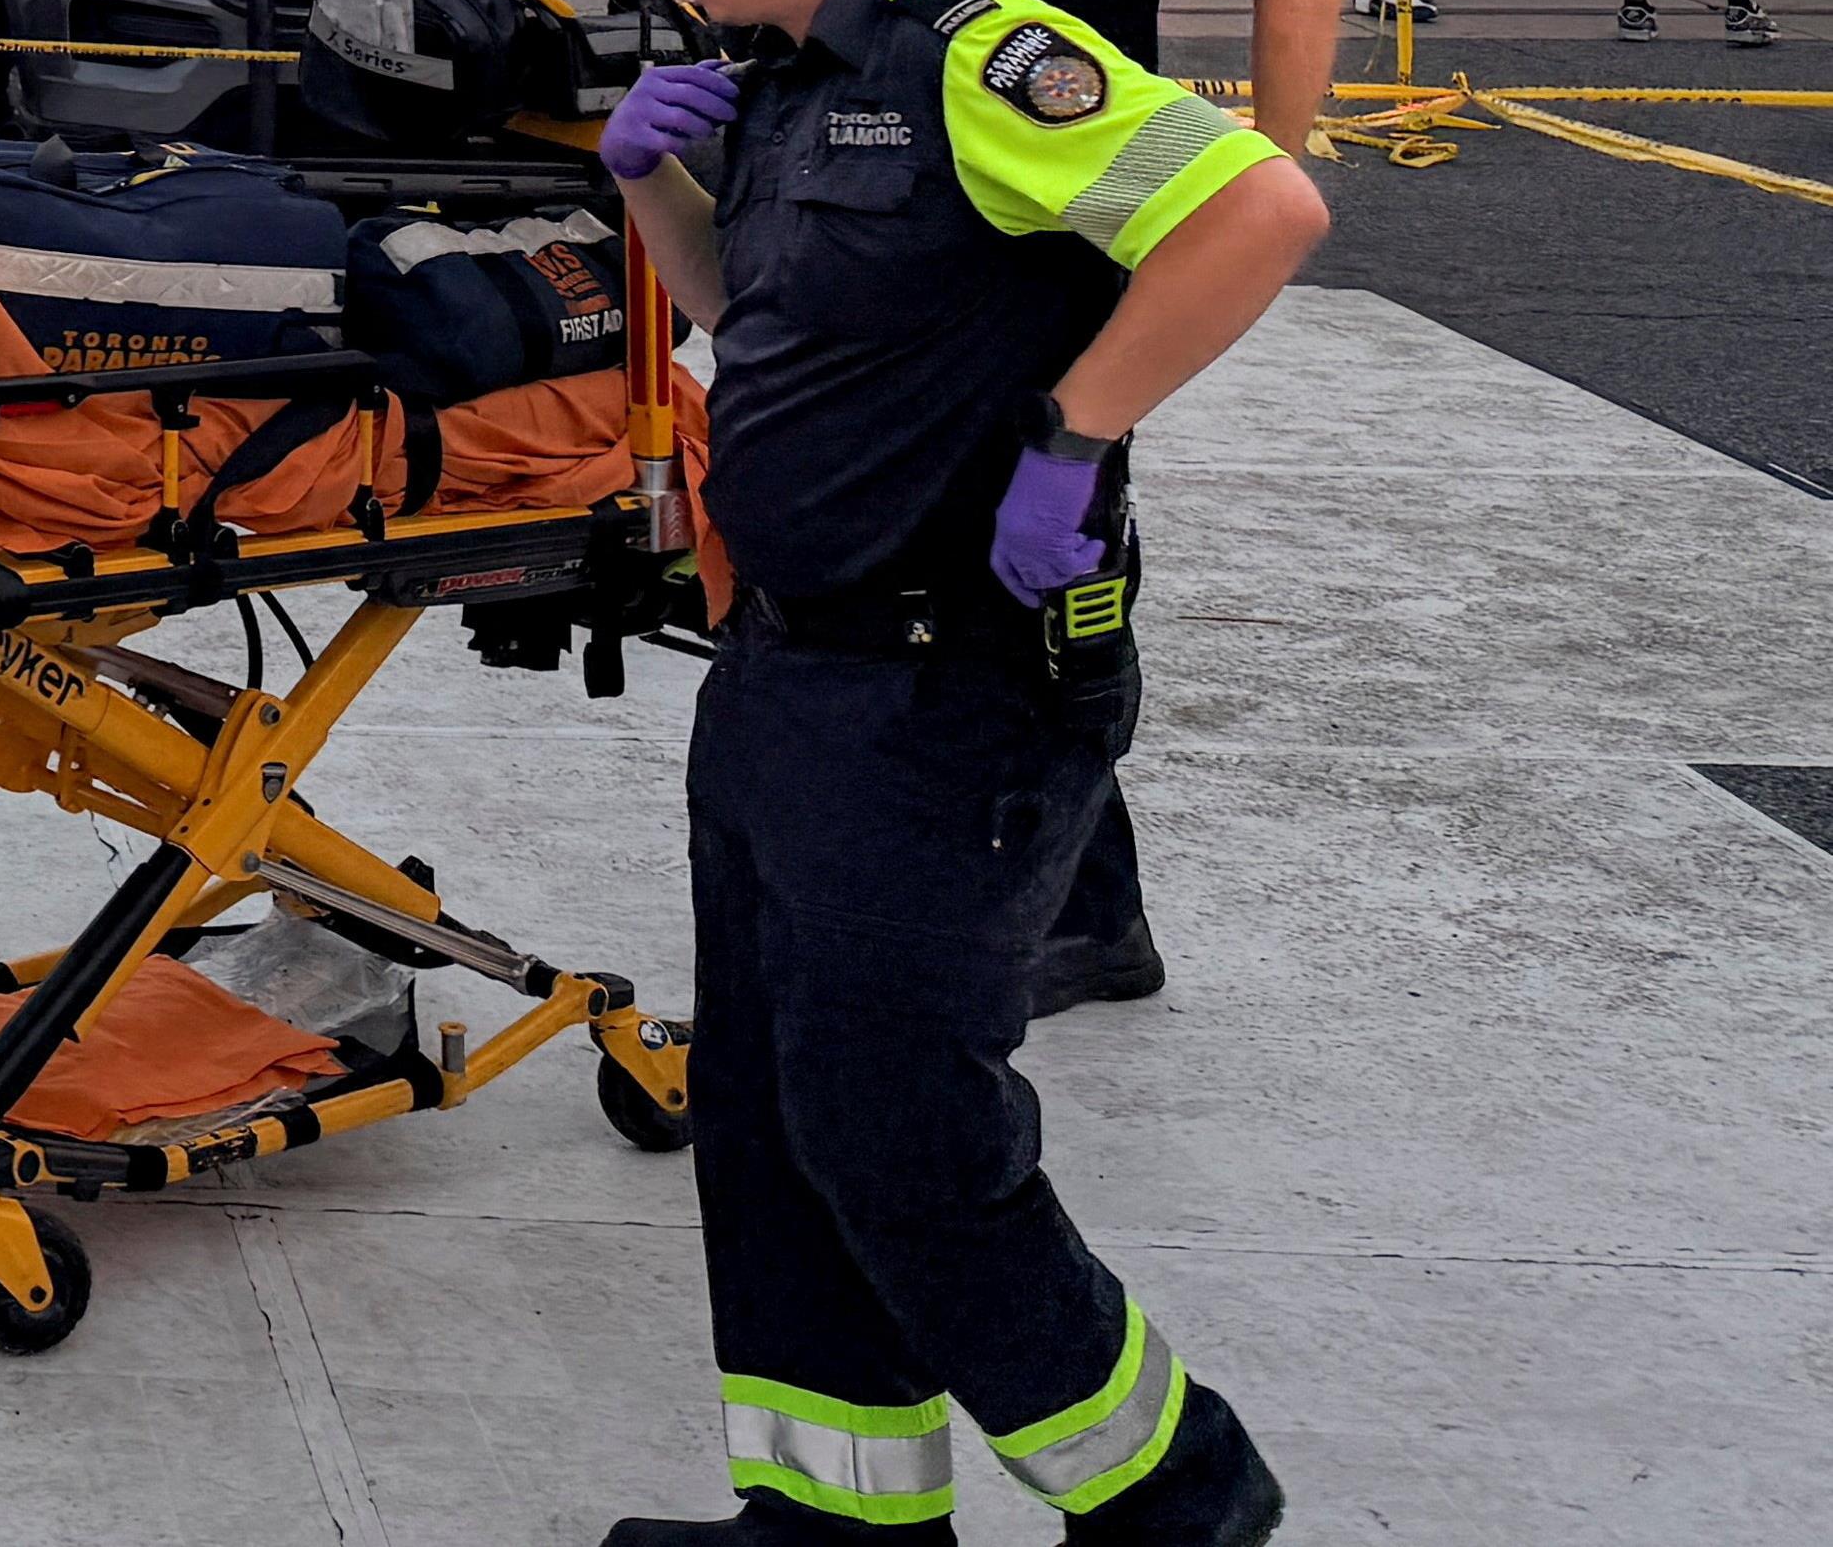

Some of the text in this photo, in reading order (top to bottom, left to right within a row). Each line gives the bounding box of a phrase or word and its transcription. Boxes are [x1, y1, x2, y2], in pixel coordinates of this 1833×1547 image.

[344, 39, 406, 74] Series
[63, 330, 209, 352] TORONTO
[559, 313, 600, 344] FIRST
